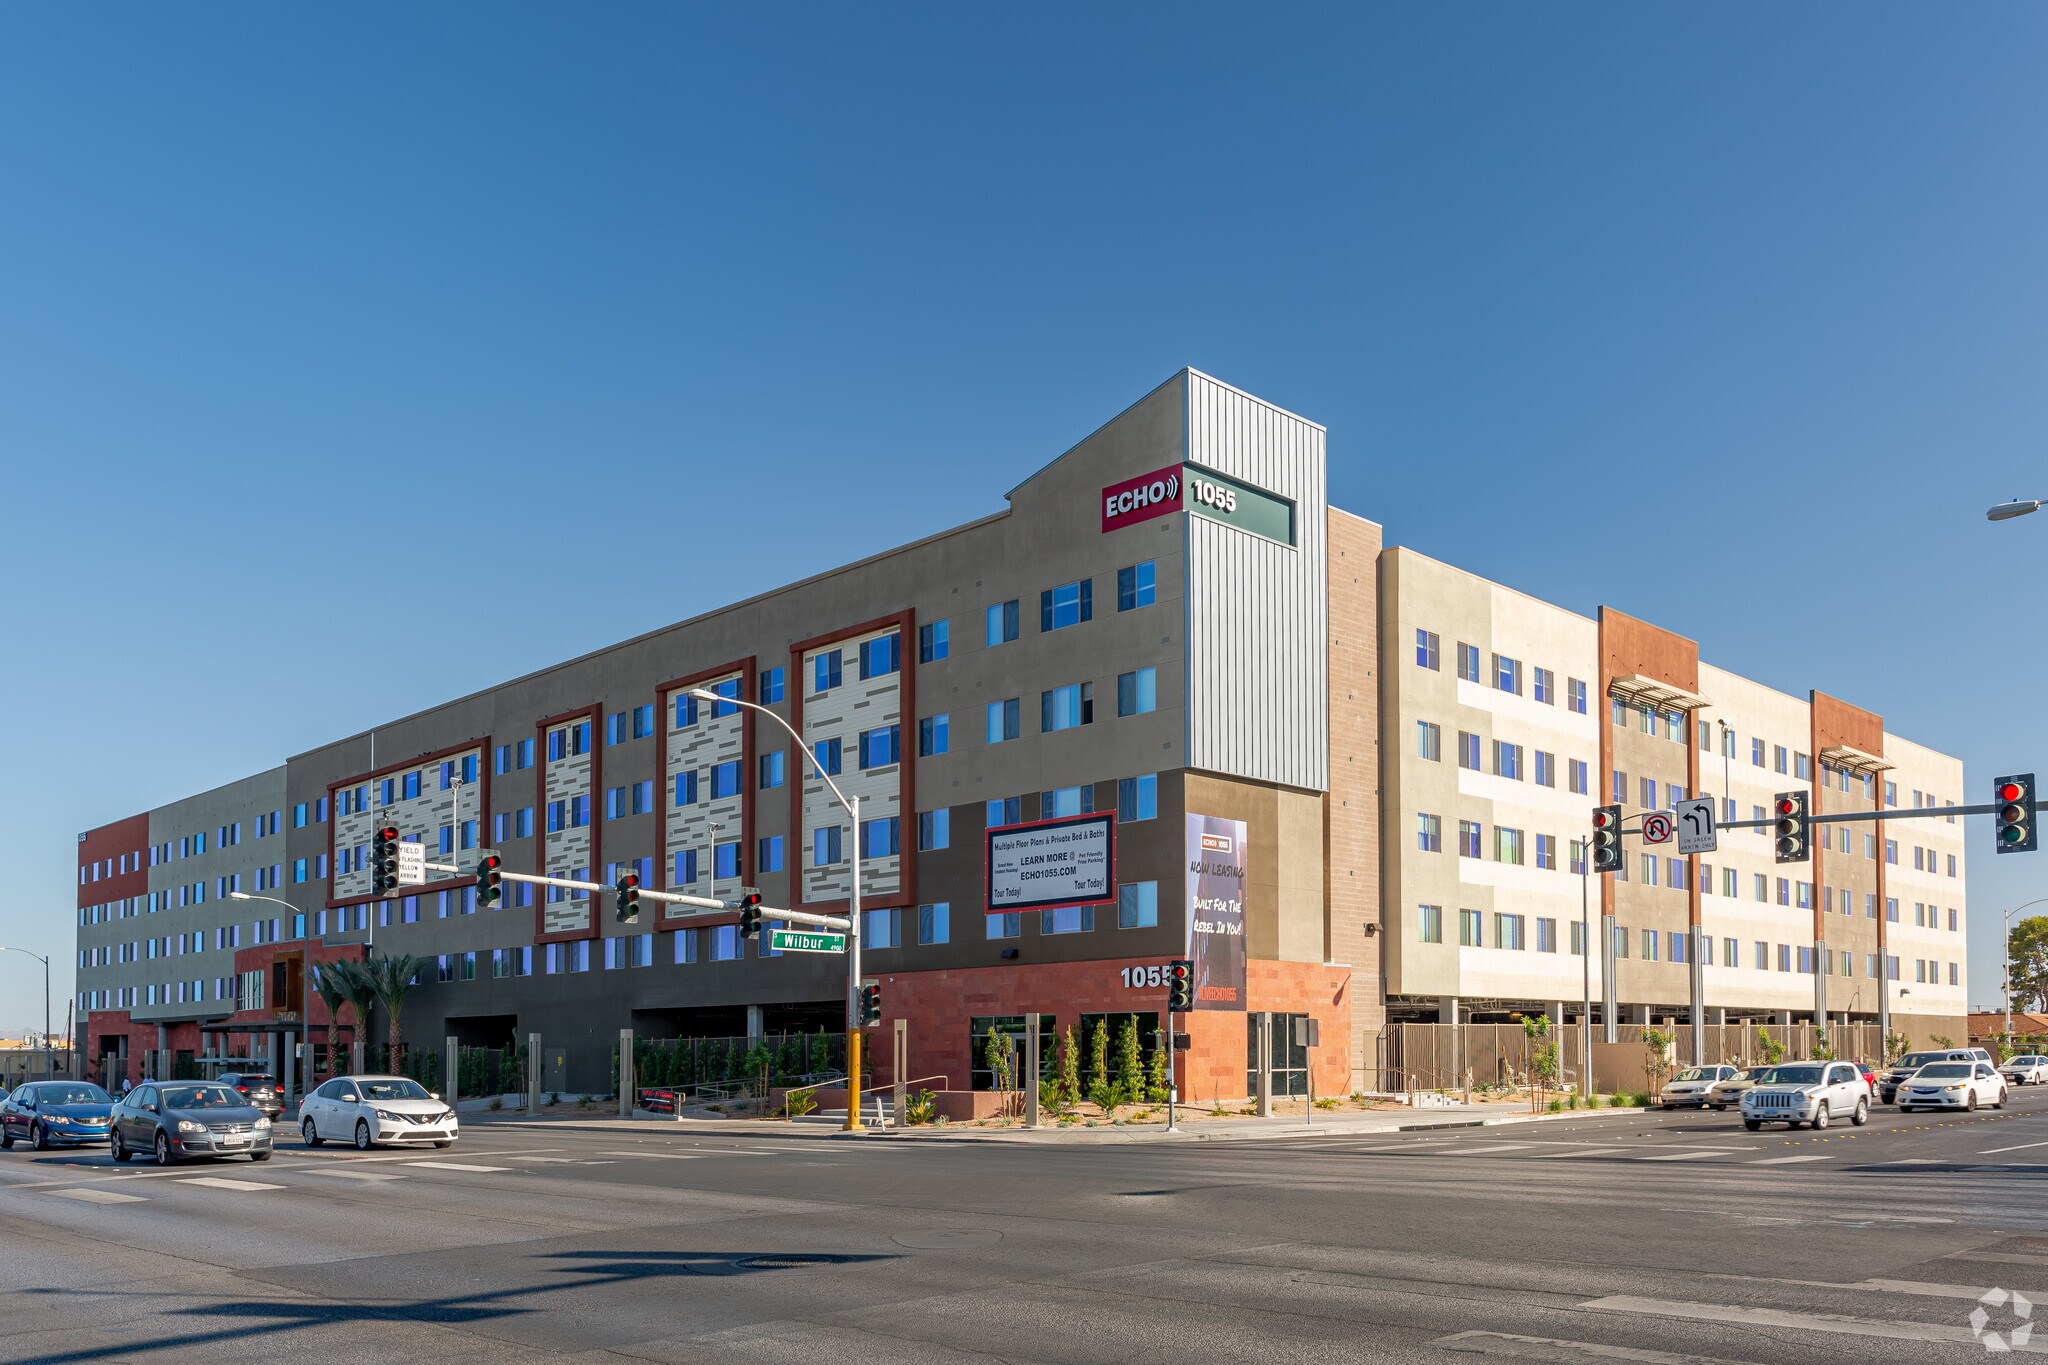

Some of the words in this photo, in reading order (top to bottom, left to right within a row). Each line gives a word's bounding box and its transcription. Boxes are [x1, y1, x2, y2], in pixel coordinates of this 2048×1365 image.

[1106, 481, 1166, 518] ECHO
[1193, 479, 1237, 512] 1055
[994, 840, 1015, 851] Multiple
[1016, 839, 1029, 849] Floor
[1030, 837, 1044, 847] Plans
[1045, 836, 1050, 844] &
[1051, 834, 1071, 844] Private
[1071, 832, 1082, 841] Bed
[1084, 831, 1088, 839] &
[1089, 829, 1105, 839] Baths
[1020, 855, 1044, 866] LEARN
[1046, 852, 1068, 862] MORE
[1069, 851, 1075, 861] @
[1020, 866, 1077, 880] ECHO1055.COM
[1190, 861, 1209, 875] NOW
[1212, 863, 1244, 879] LEASING
[1074, 880, 1086, 890] Tour
[1087, 877, 1105, 889] Today!
[994, 889, 1005, 898] Tour
[1006, 887, 1021, 898] Today!
[784, 934, 823, 949] Wilbur
